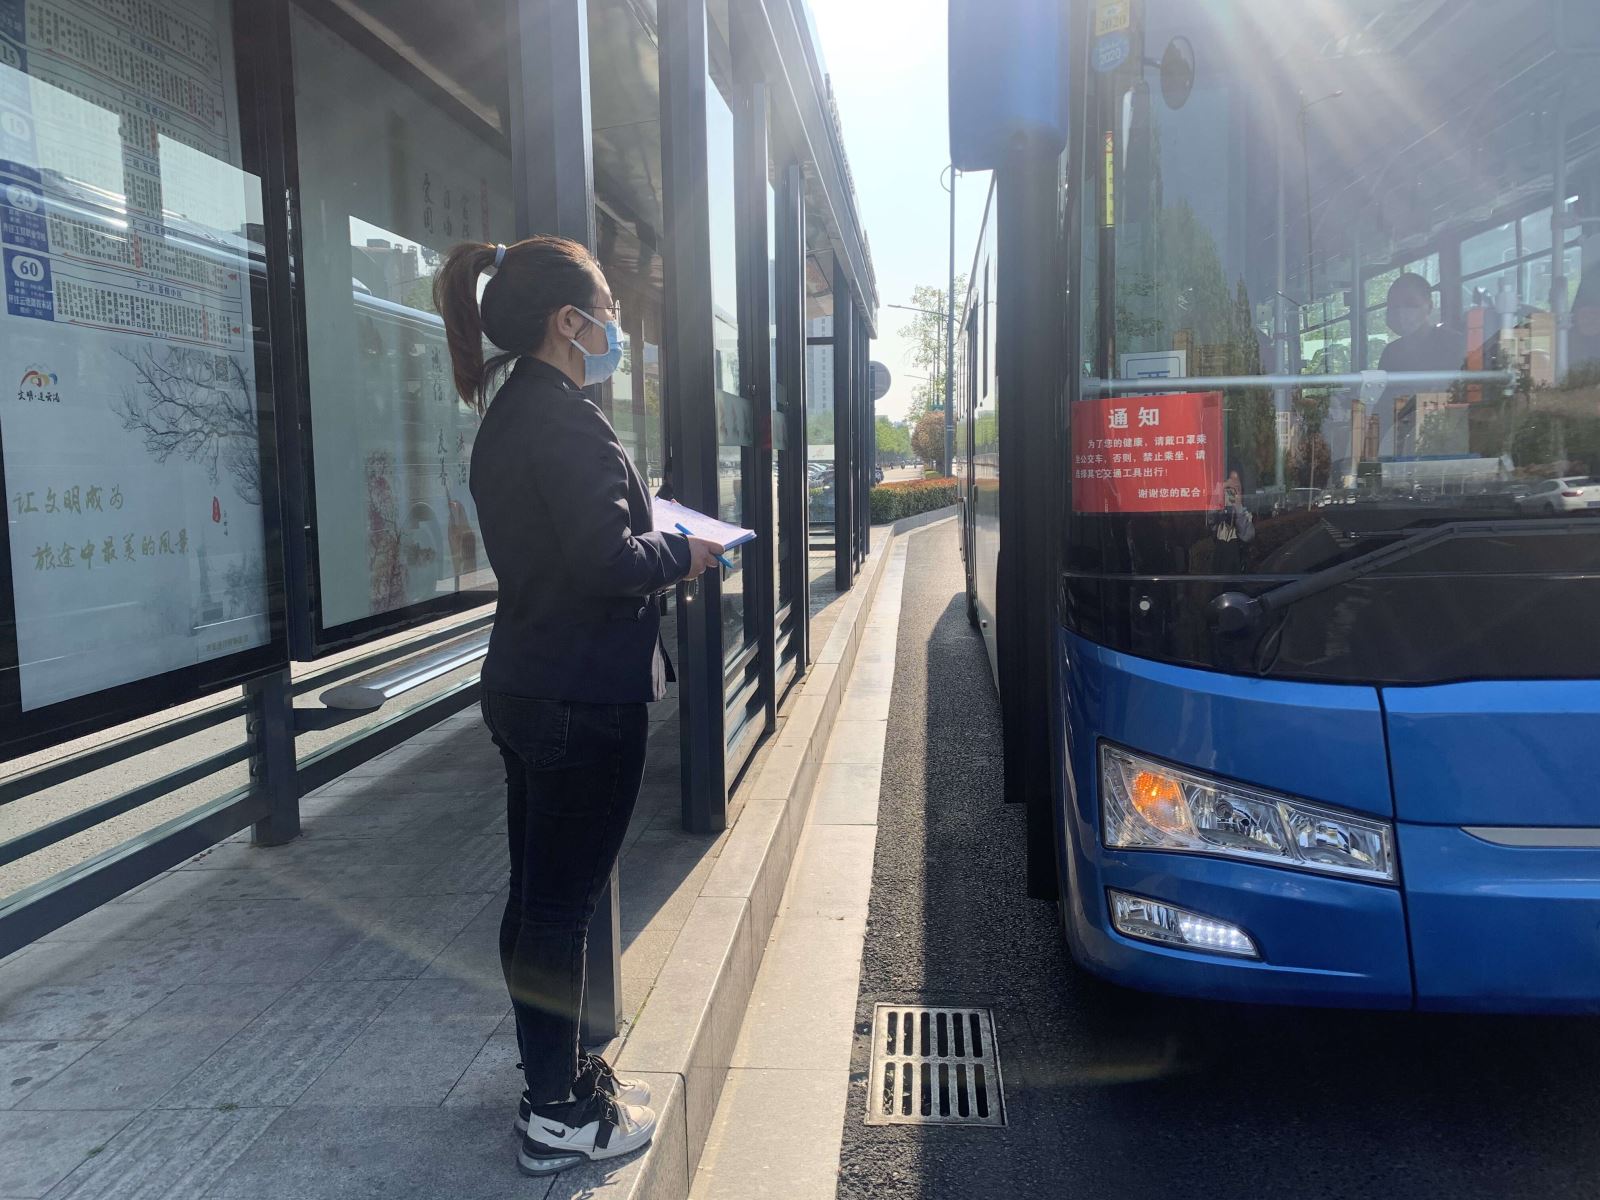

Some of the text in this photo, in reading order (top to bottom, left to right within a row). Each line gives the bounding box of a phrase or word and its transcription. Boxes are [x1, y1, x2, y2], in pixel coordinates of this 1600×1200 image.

[20, 260, 38, 276] 60
[1108, 407, 1160, 429] 通知
[1088, 434, 1207, 449] 为了您的健康，请戴口罩乘
[13, 484, 124, 515] 让文明成为
[1138, 487, 1206, 498] 谢谢您的配合！
